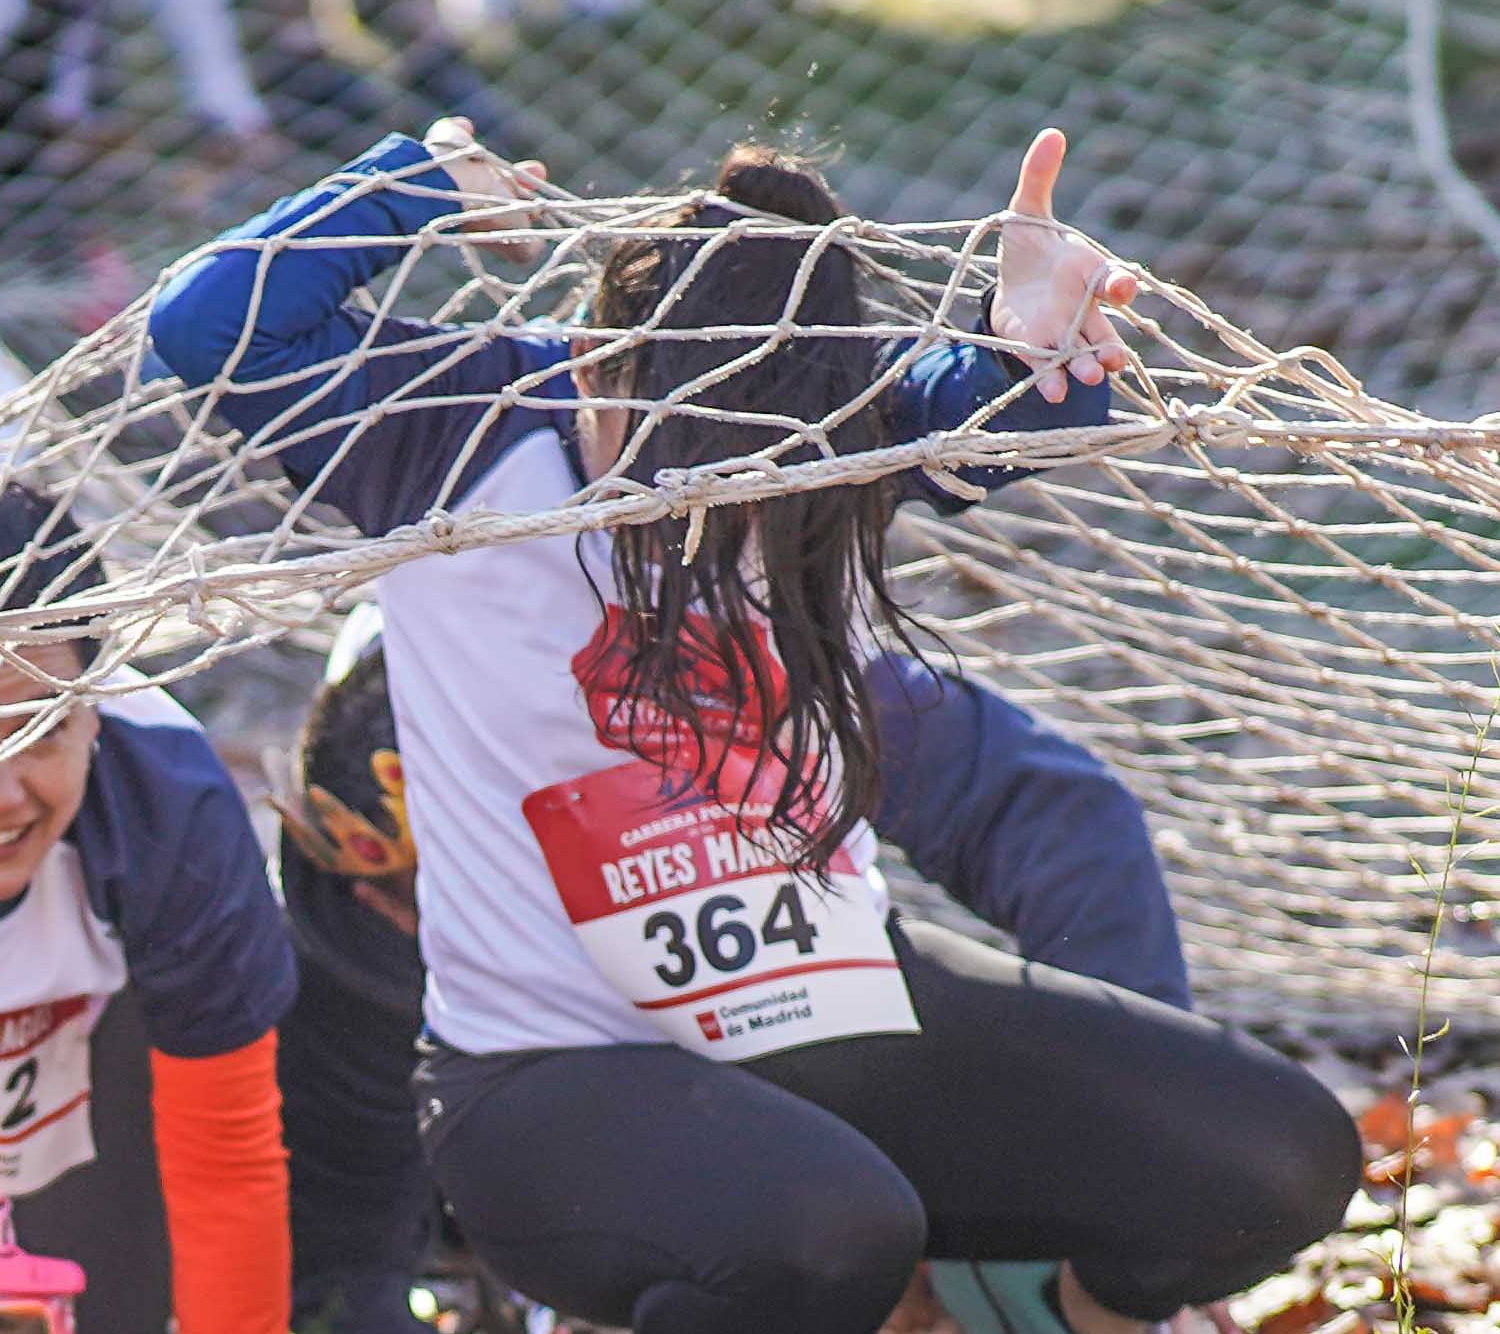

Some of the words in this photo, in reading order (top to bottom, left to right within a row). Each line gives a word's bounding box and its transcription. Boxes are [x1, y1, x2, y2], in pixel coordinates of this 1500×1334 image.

[602, 842, 697, 904] REYES
[644, 882, 818, 987] 364
[748, 1004, 813, 1031] Madrid
